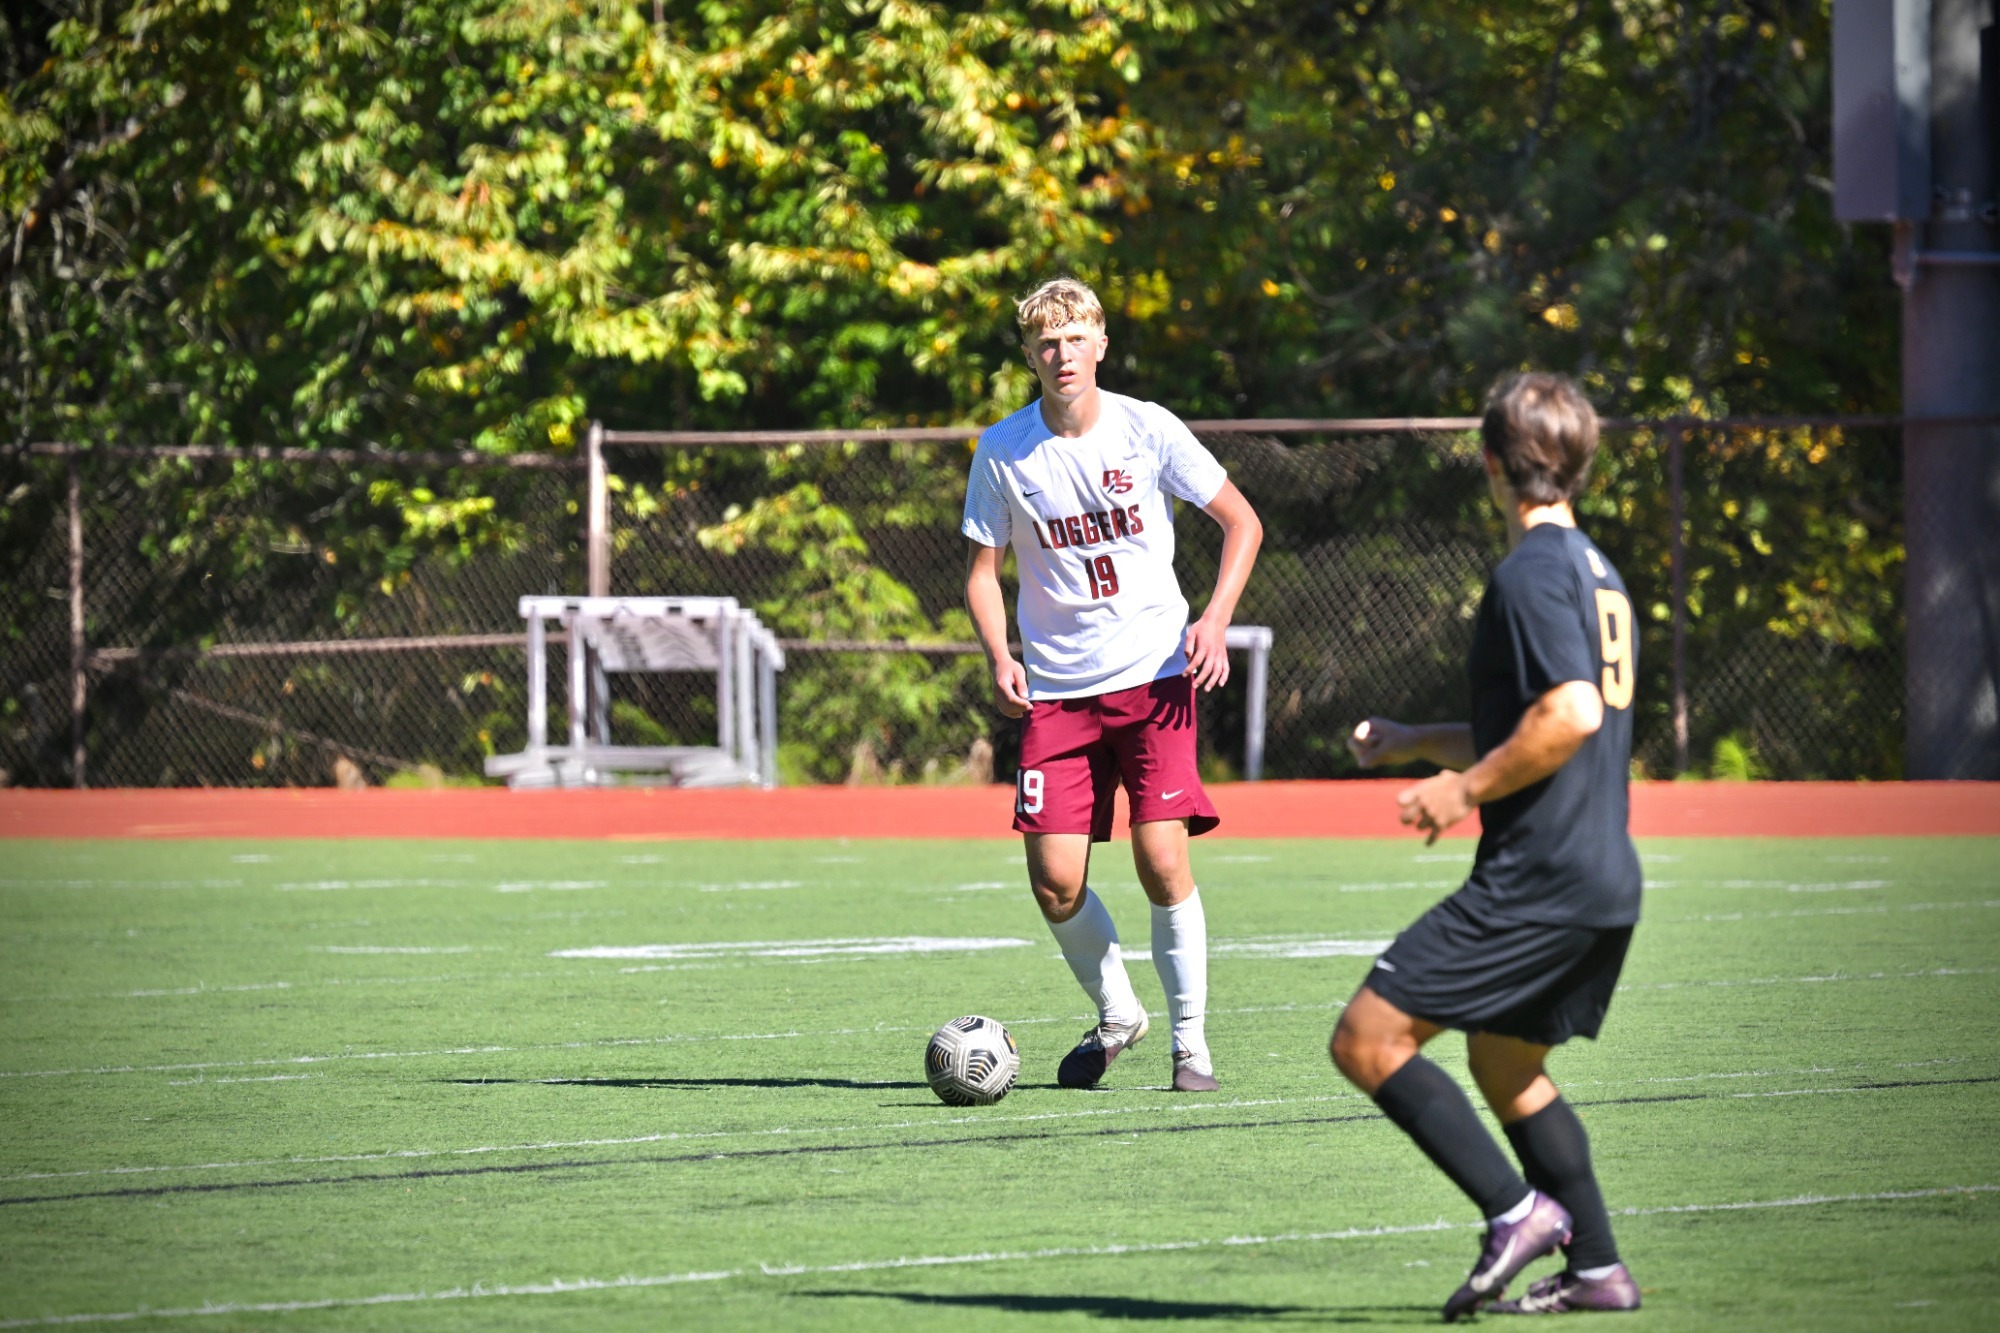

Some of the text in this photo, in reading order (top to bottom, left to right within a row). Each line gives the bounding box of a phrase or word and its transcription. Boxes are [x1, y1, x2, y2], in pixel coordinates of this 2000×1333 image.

[1033, 503, 1144, 549] LOGGERS
[1085, 555, 1119, 600] 19
[1595, 588, 1634, 710] 9
